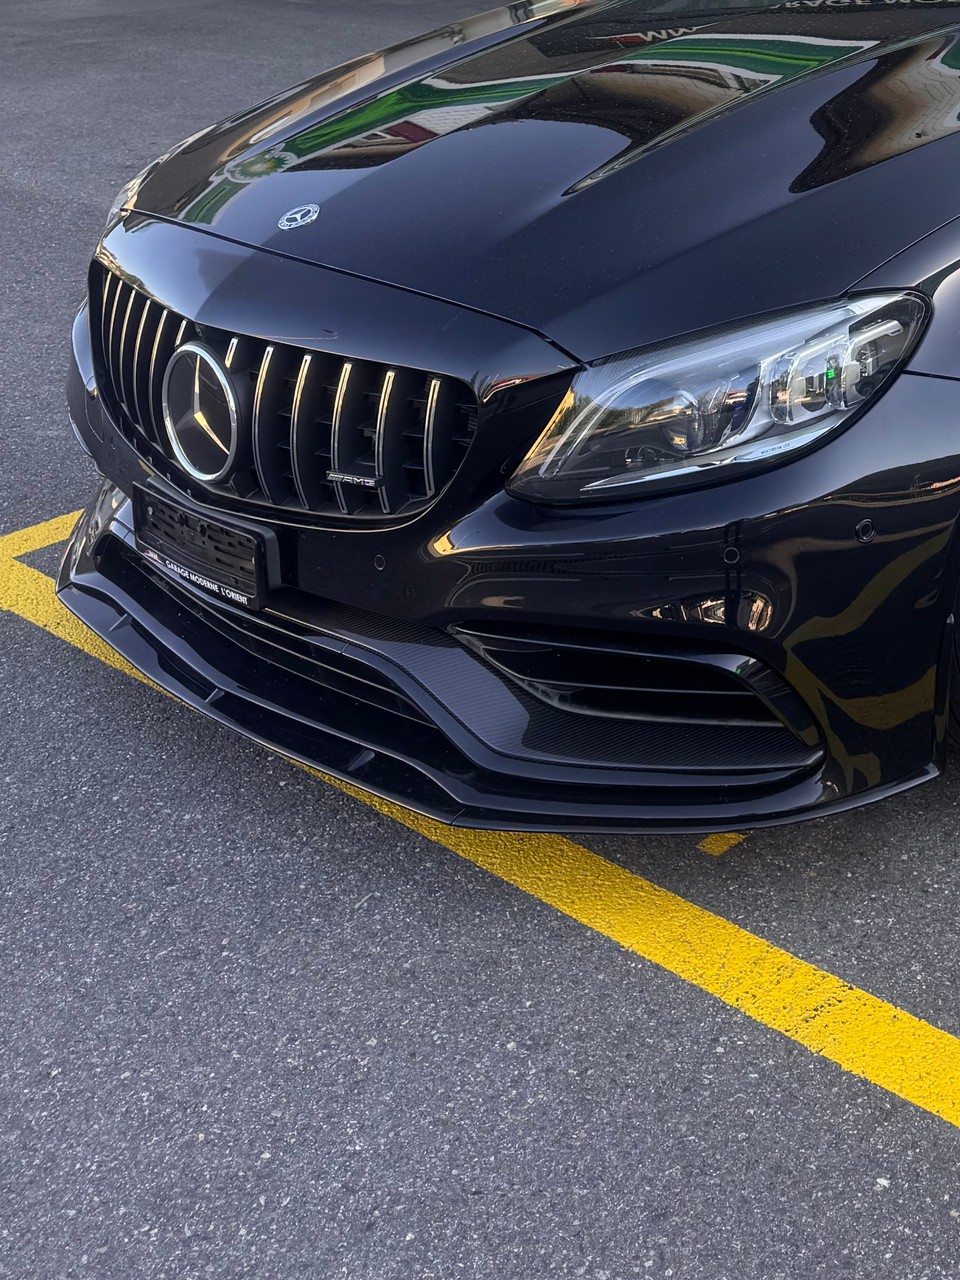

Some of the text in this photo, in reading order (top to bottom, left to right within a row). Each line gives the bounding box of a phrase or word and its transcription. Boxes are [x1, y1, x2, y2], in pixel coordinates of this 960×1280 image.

[342, 476, 375, 486] AMG
[165, 560, 190, 579] GARAGE
[190, 573, 219, 593] MODERNE
[221, 587, 248, 605] L'ORIENT
